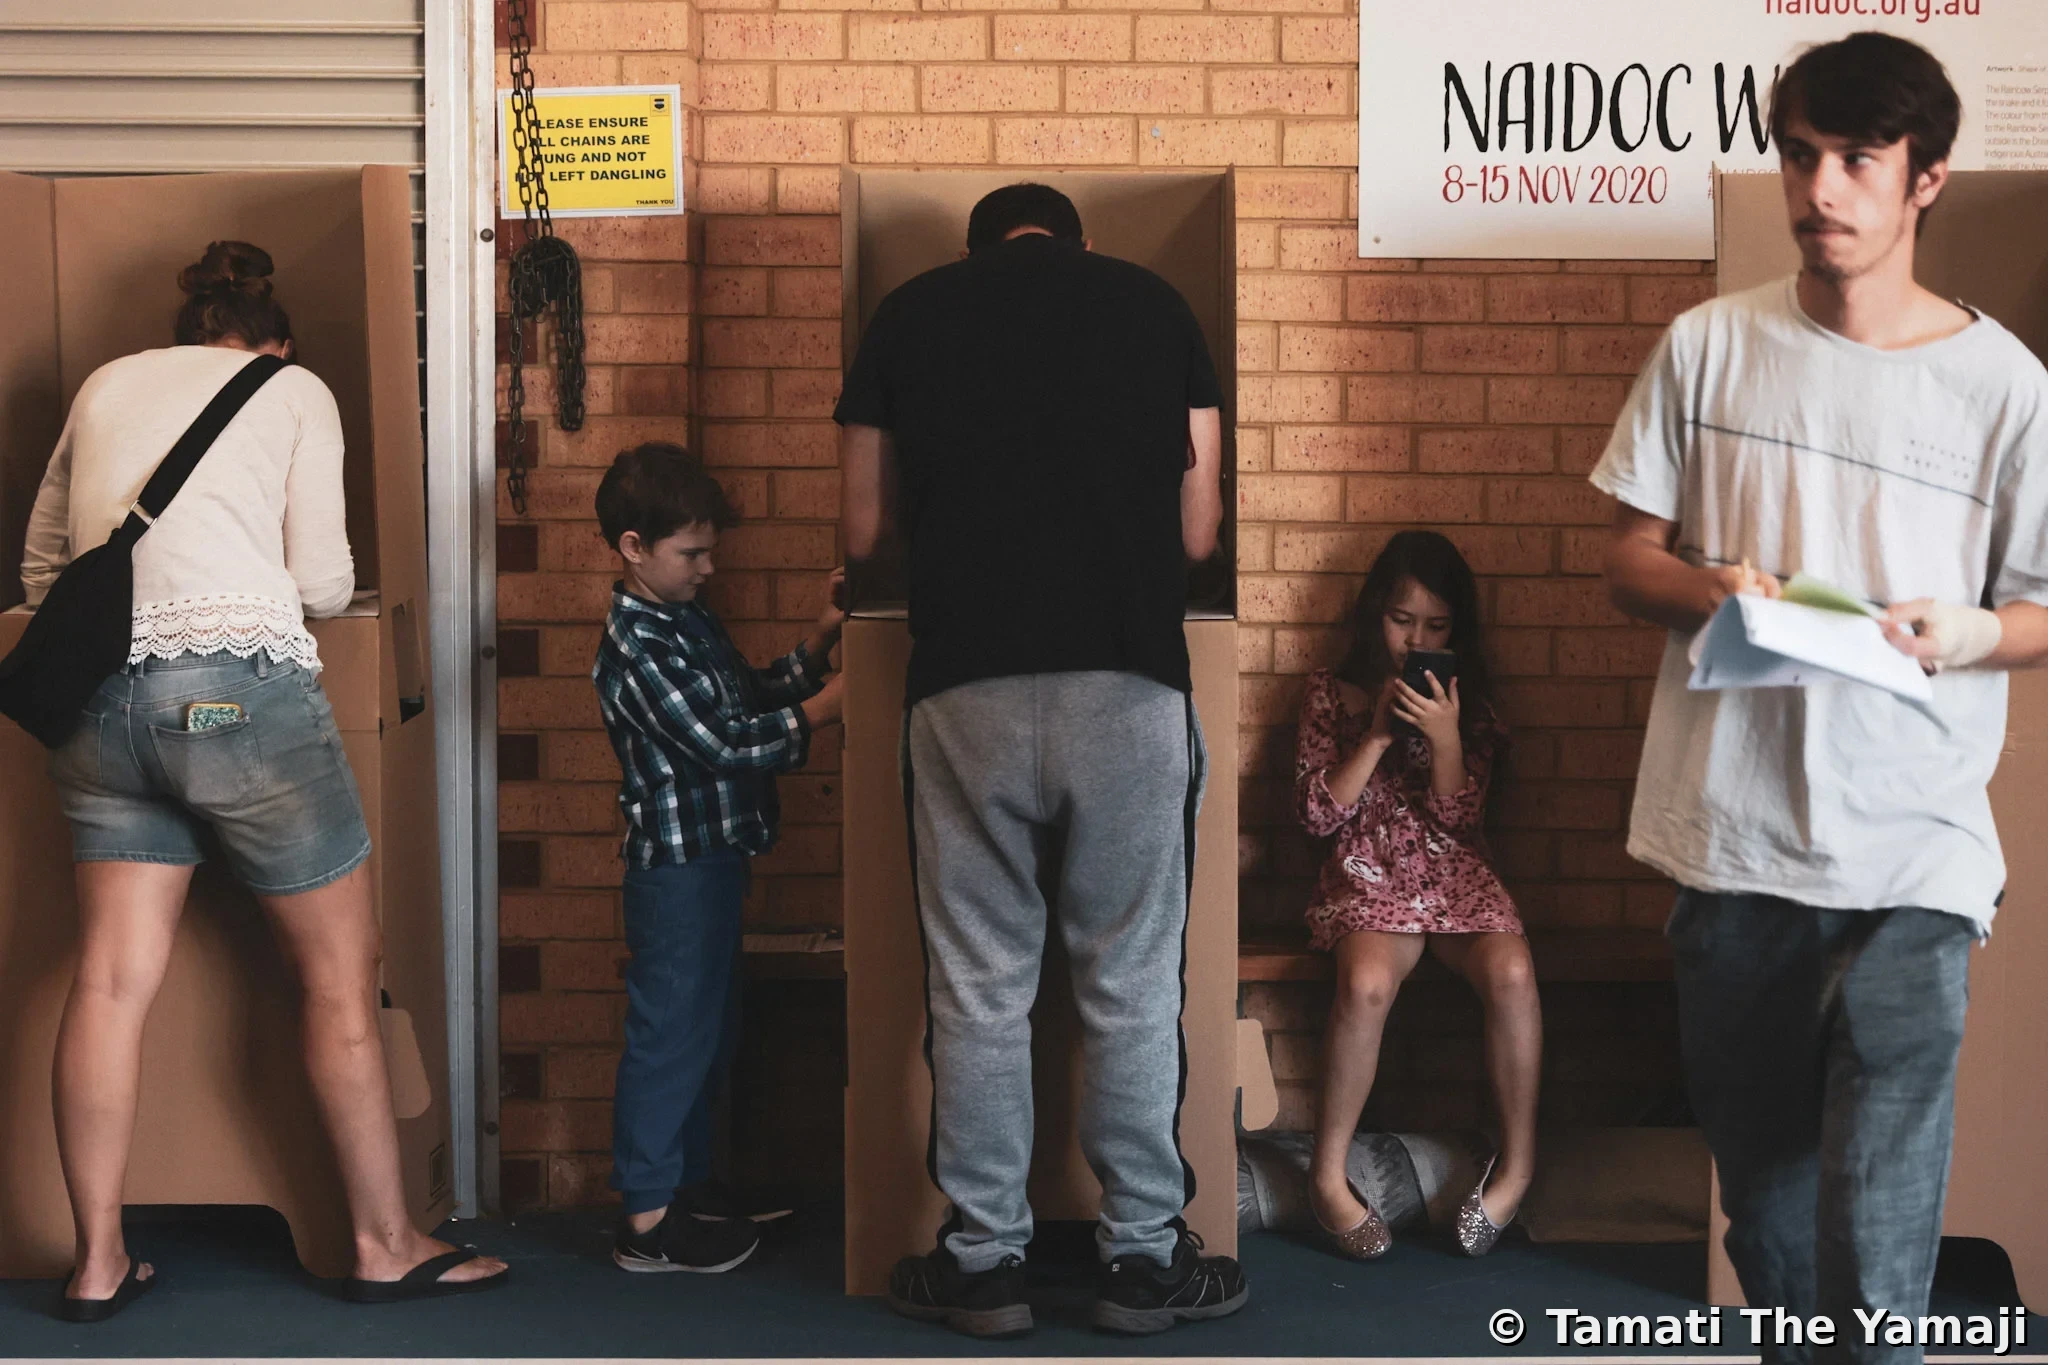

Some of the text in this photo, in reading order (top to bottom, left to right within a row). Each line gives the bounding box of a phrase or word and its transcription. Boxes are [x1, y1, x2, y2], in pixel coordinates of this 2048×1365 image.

[1766, 0, 1980, 23] naidoc.org.au
[1444, 60, 1780, 154] NAIDOC W
[530, 117, 649, 129] LEASE ENSURE
[560, 135, 616, 147] CHAINS
[621, 135, 650, 145] ARE
[581, 152, 611, 163] AND
[616, 151, 647, 162] NOT
[550, 171, 585, 181] LEFT
[590, 169, 667, 181] DANGLING
[1442, 165, 1667, 204] 8-15 NOV 2020
